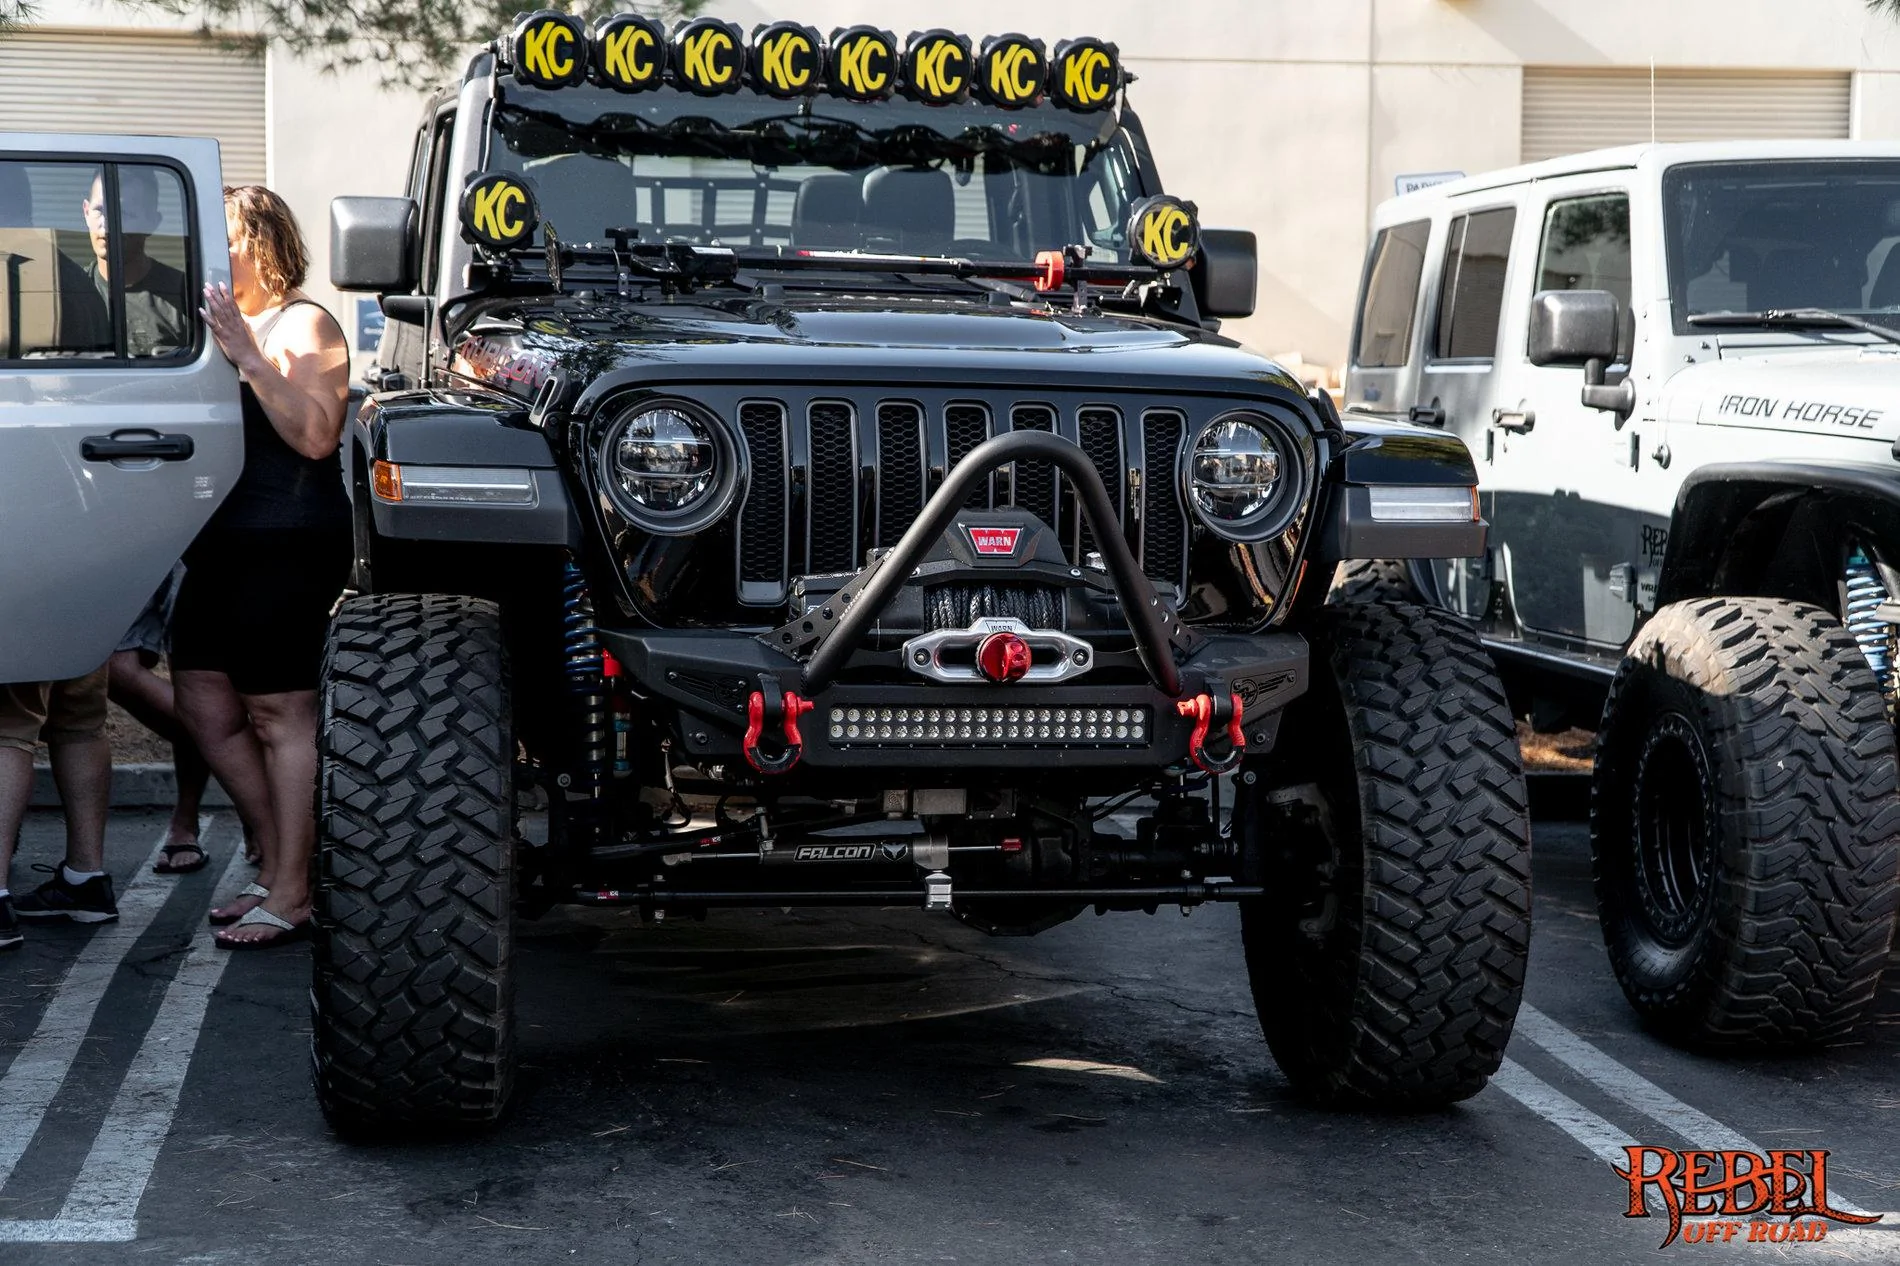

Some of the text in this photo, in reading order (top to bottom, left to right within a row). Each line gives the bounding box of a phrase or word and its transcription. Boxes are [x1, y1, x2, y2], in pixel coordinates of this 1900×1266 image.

[526, 22, 574, 80] KC
[606, 26, 653, 83] KC
[685, 29, 732, 86] KC
[763, 33, 810, 90] KC
[840, 36, 887, 93] KC
[916, 40, 962, 96] KC
[991, 44, 1037, 100] KC
[1065, 48, 1110, 104] KC
[474, 181, 526, 239] KC
[1143, 205, 1189, 263] KC
[1718, 394, 1884, 429] IRON HORSE
[977, 536, 1011, 546] WARN
[798, 846, 871, 860] FALCON
